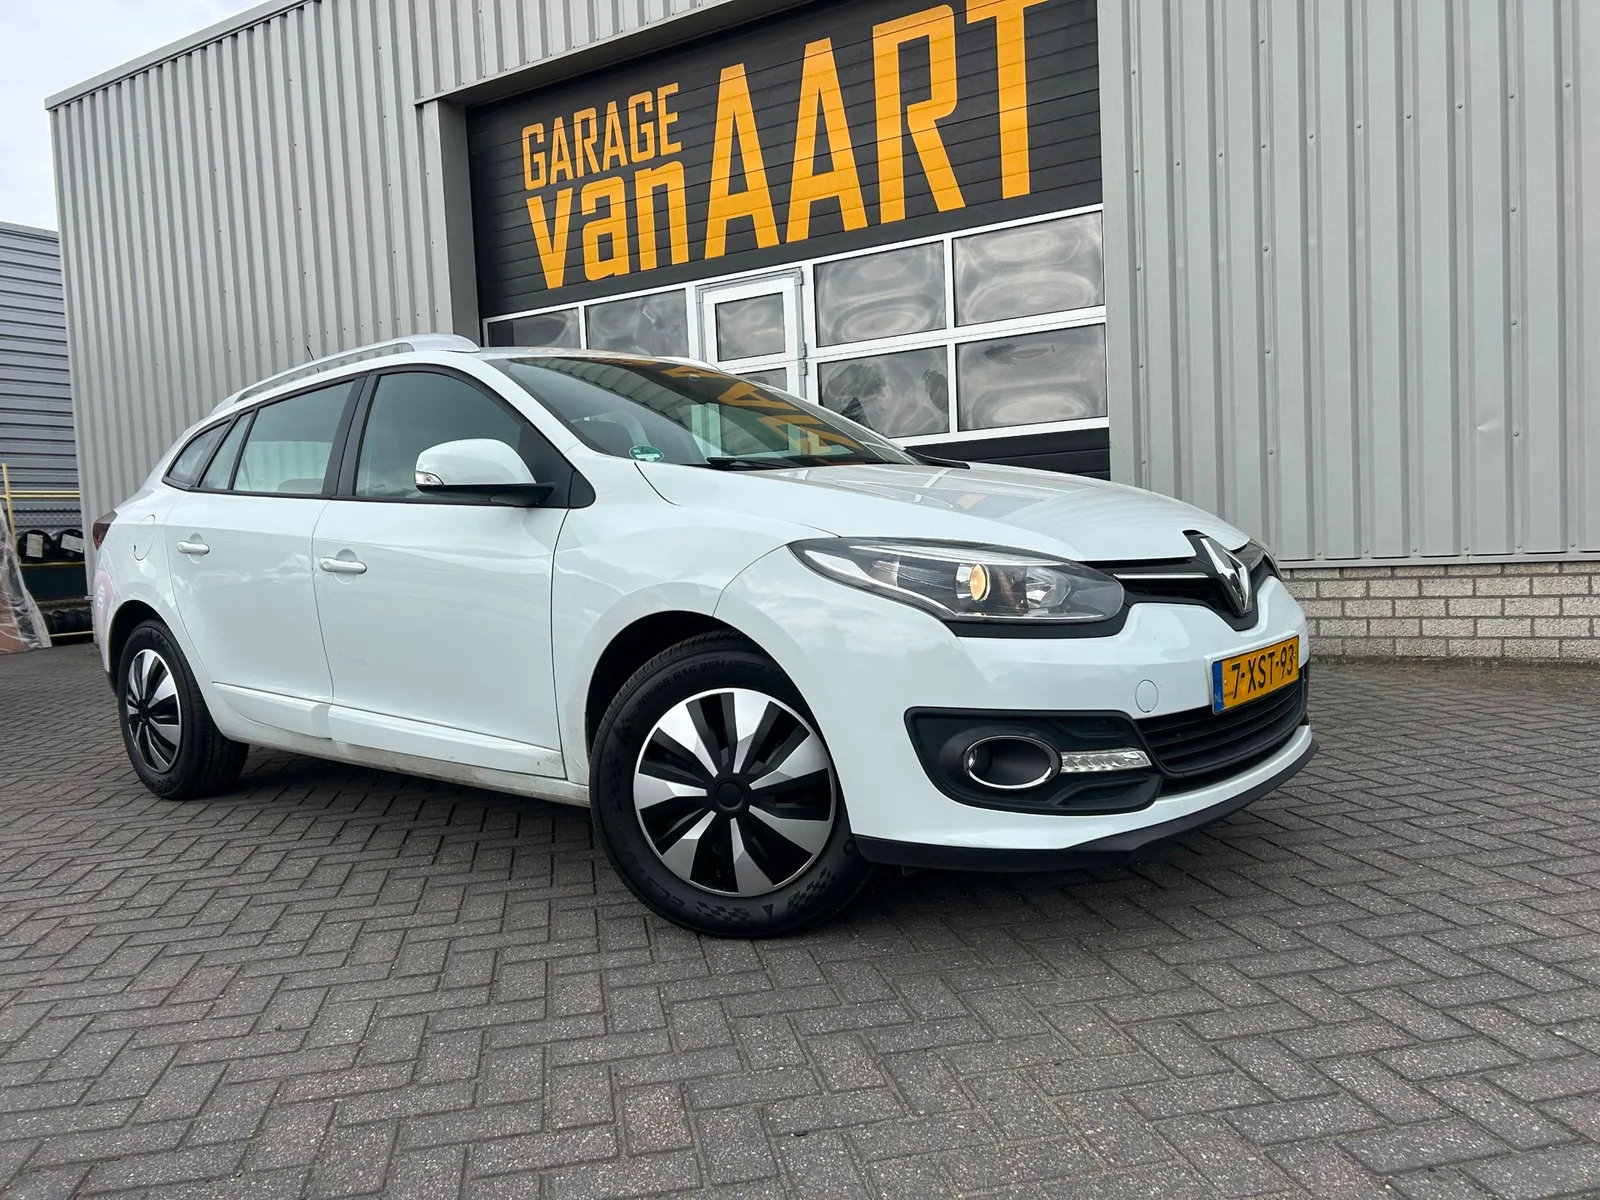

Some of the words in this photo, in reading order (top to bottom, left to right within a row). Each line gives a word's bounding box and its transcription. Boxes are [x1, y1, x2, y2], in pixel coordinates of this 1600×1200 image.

[521, 82, 682, 191] GARAGE
[526, 160, 689, 289] van
[705, 0, 1049, 260] AART
[1231, 643, 1295, 700] 7-XST-93
